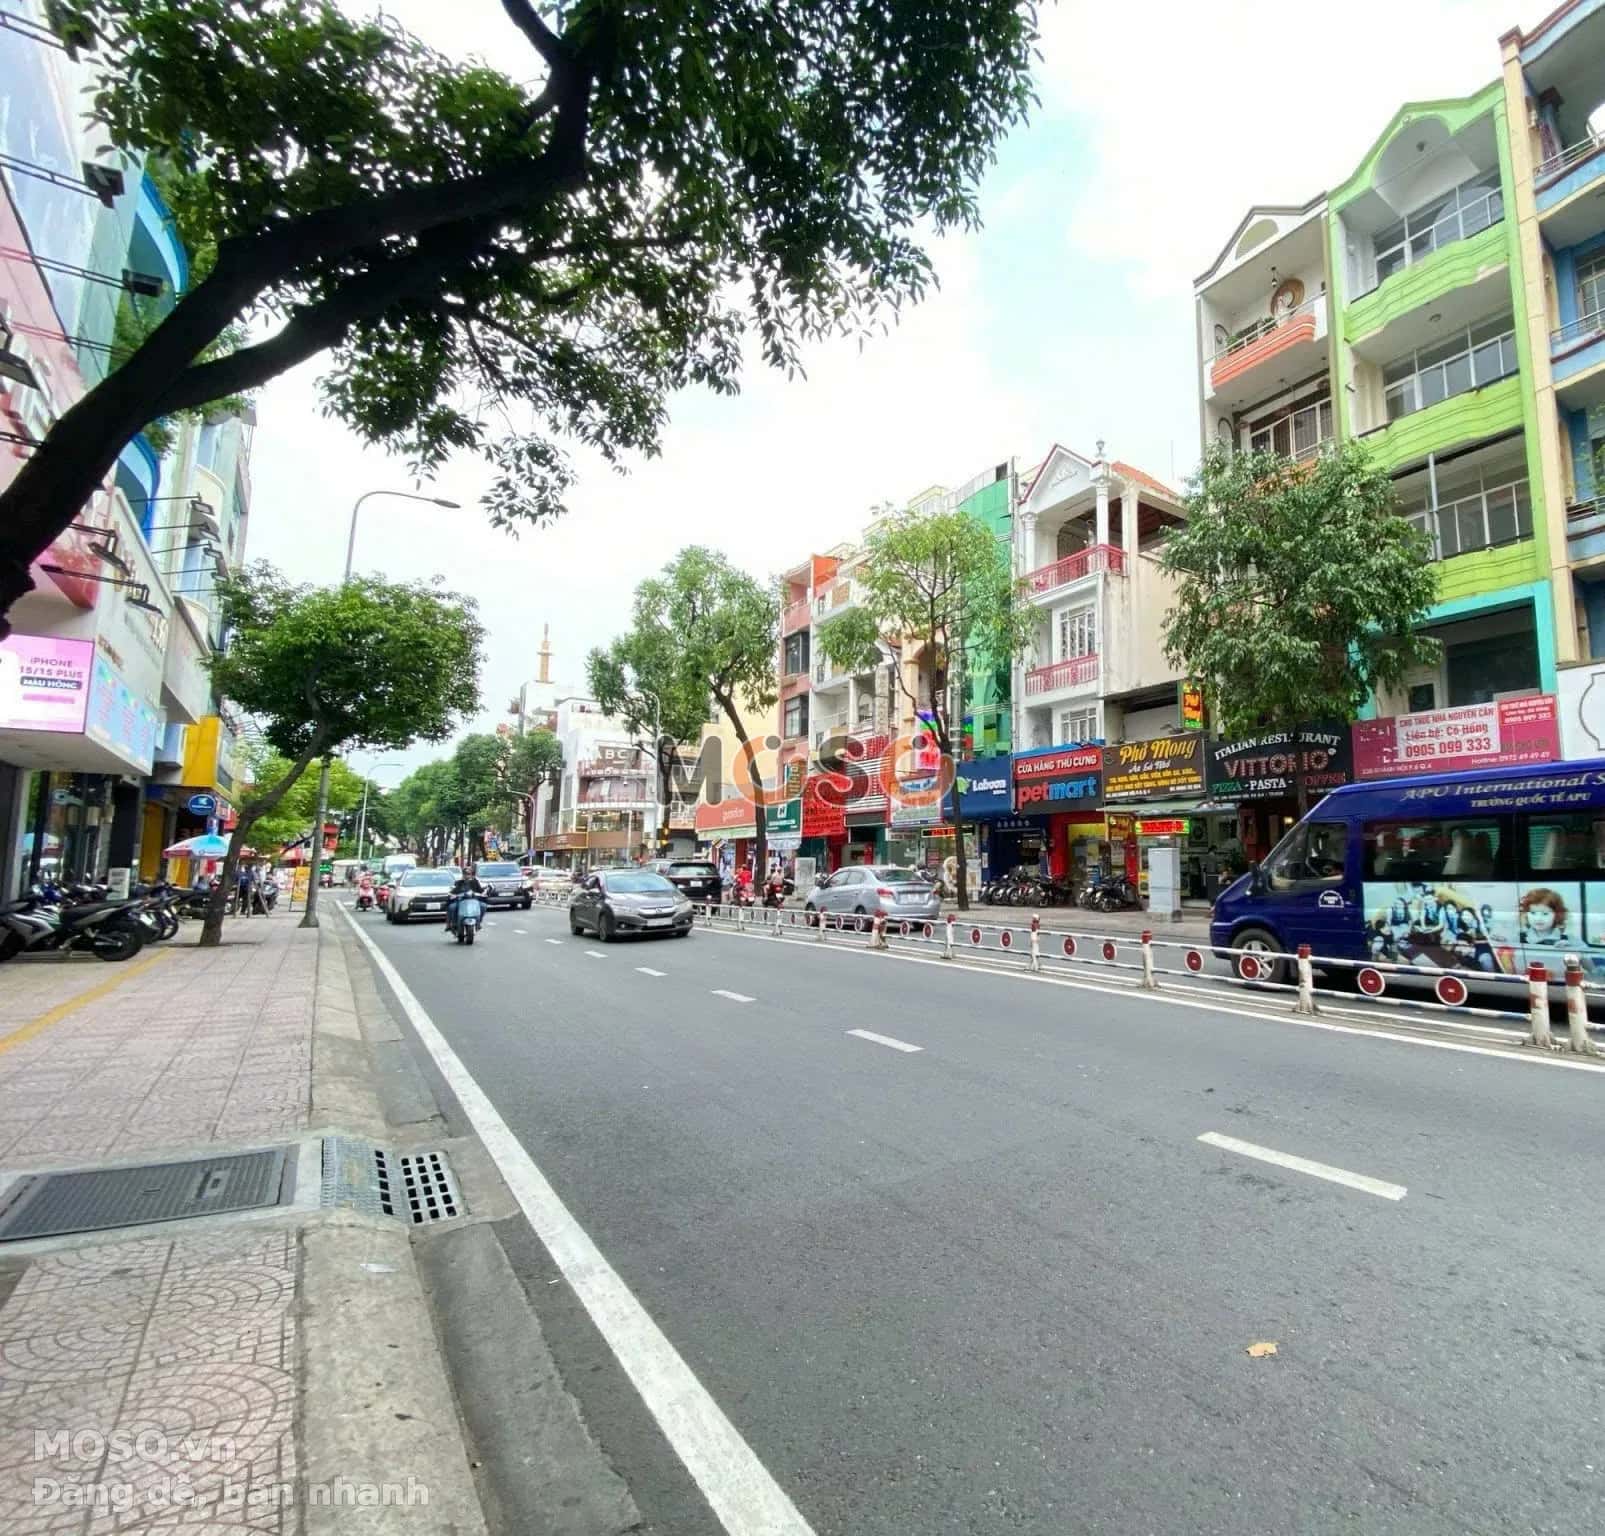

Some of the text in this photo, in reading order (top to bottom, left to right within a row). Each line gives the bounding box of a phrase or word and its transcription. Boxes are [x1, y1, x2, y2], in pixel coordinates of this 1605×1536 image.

[30, 656, 73, 667] iPHONE
[56, 669, 83, 678] PLUS
[1119, 741, 1147, 765] Phở
[1214, 737, 1257, 761] ITALIAN
[1406, 743, 1436, 758] 0905
[1439, 740, 1462, 754] 099
[1466, 737, 1491, 752] 333
[1074, 754, 1097, 767] CƯNG
[1018, 777, 1096, 809] petmart
[1454, 773, 1592, 796] International
[1566, 791, 1592, 802] APU
